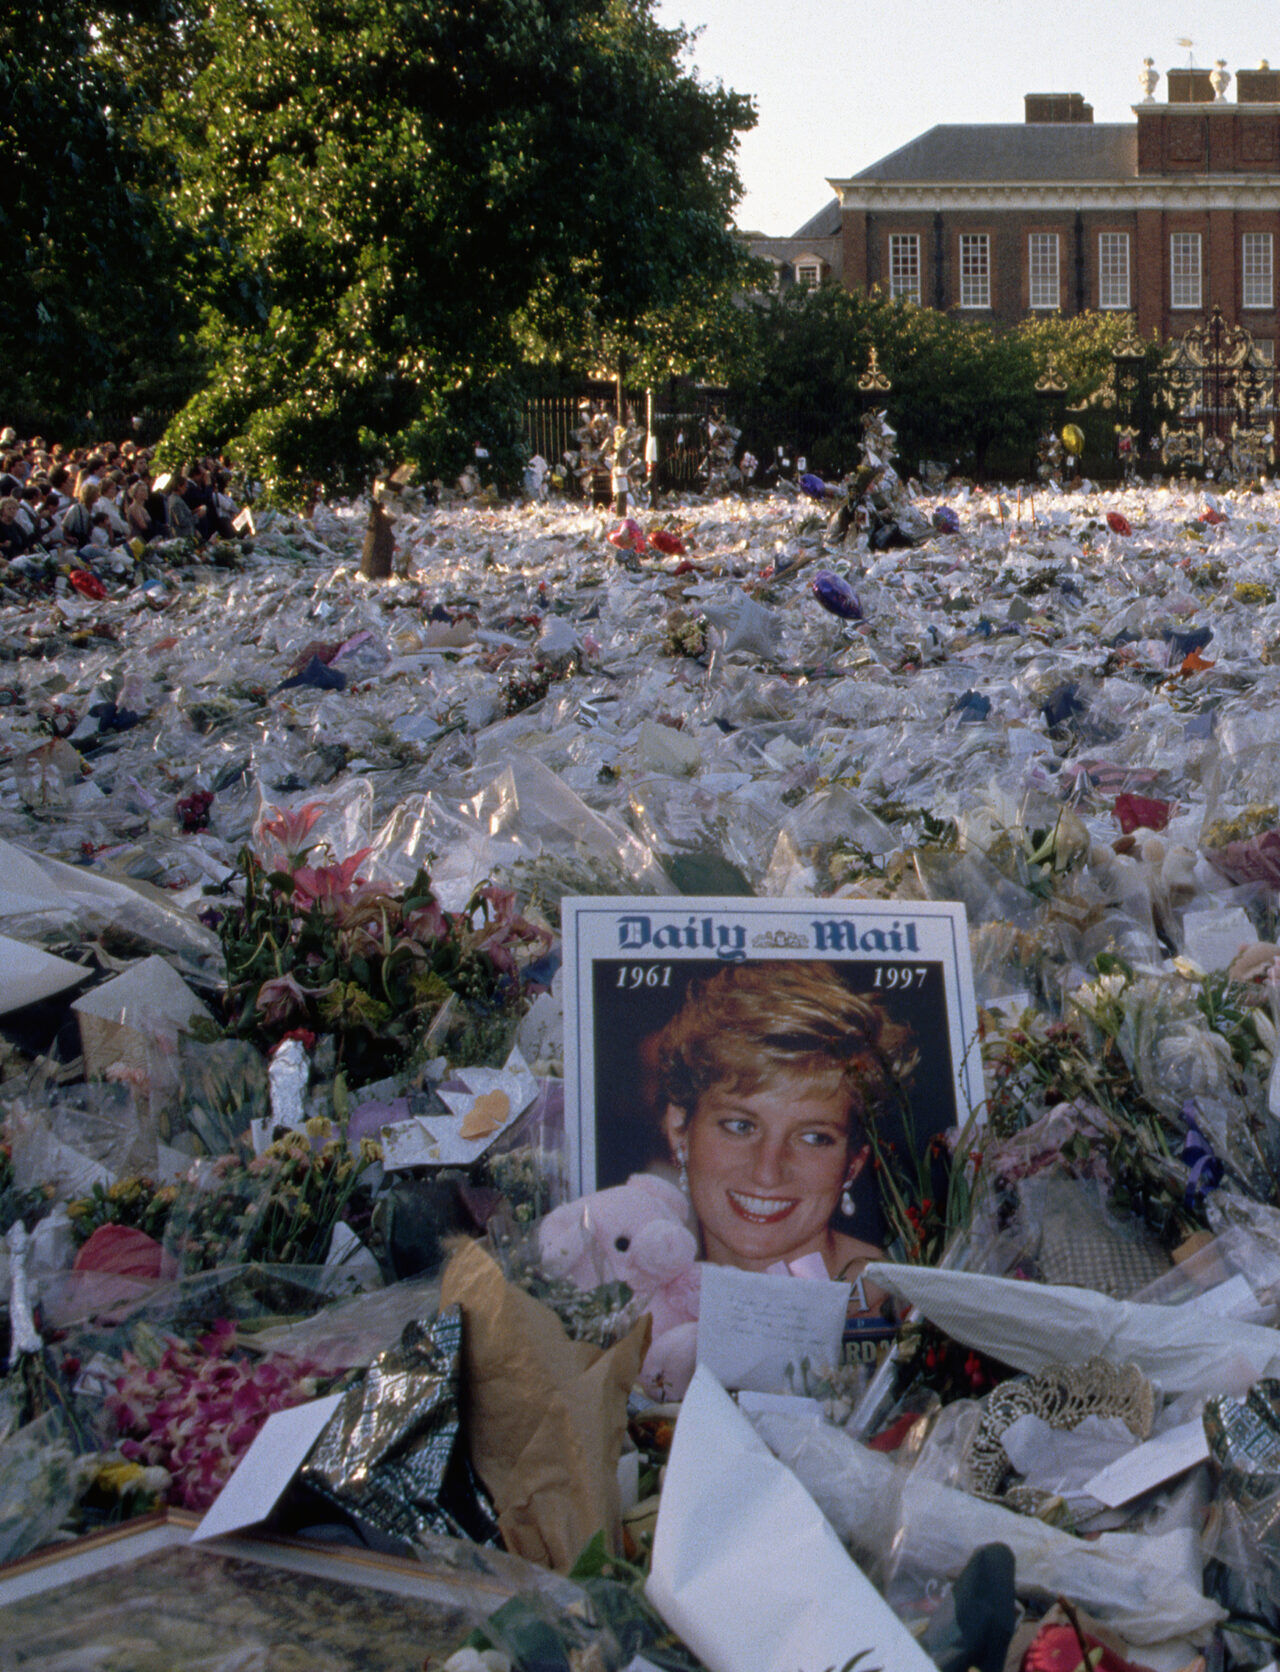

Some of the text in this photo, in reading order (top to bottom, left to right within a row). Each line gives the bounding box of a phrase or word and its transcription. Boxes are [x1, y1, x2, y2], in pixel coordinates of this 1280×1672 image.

[616, 916, 921, 962] Daily Mail
[616, 964, 928, 989] 1961 1997
[842, 1341, 877, 1363] RD
